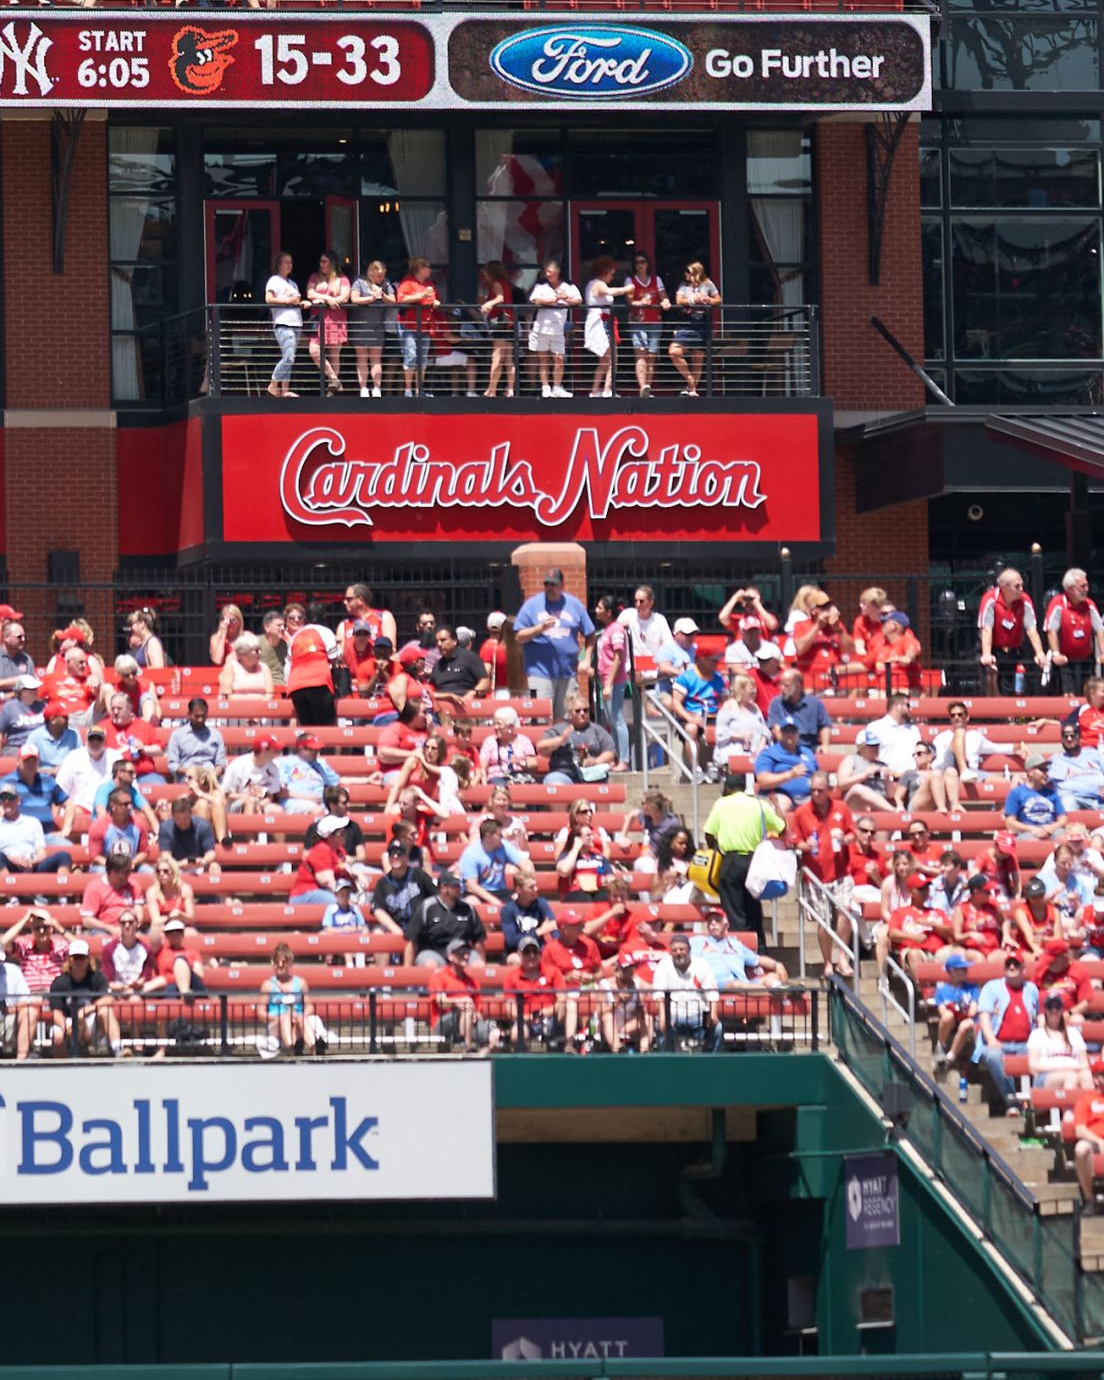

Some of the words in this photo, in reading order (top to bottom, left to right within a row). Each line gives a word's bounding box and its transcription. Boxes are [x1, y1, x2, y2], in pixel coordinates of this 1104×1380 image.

[78, 31, 147, 53] START
[254, 34, 402, 86] 15-33
[531, 33, 651, 85] Ford
[77, 57, 150, 88] 6:05
[705, 48, 755, 79] Go
[761, 48, 885, 79] Further
[280, 426, 545, 528] Cardinals
[534, 426, 767, 527] Nation
[16, 1096, 379, 1191] Ballpark
[551, 1340, 629, 1359] HYATT
